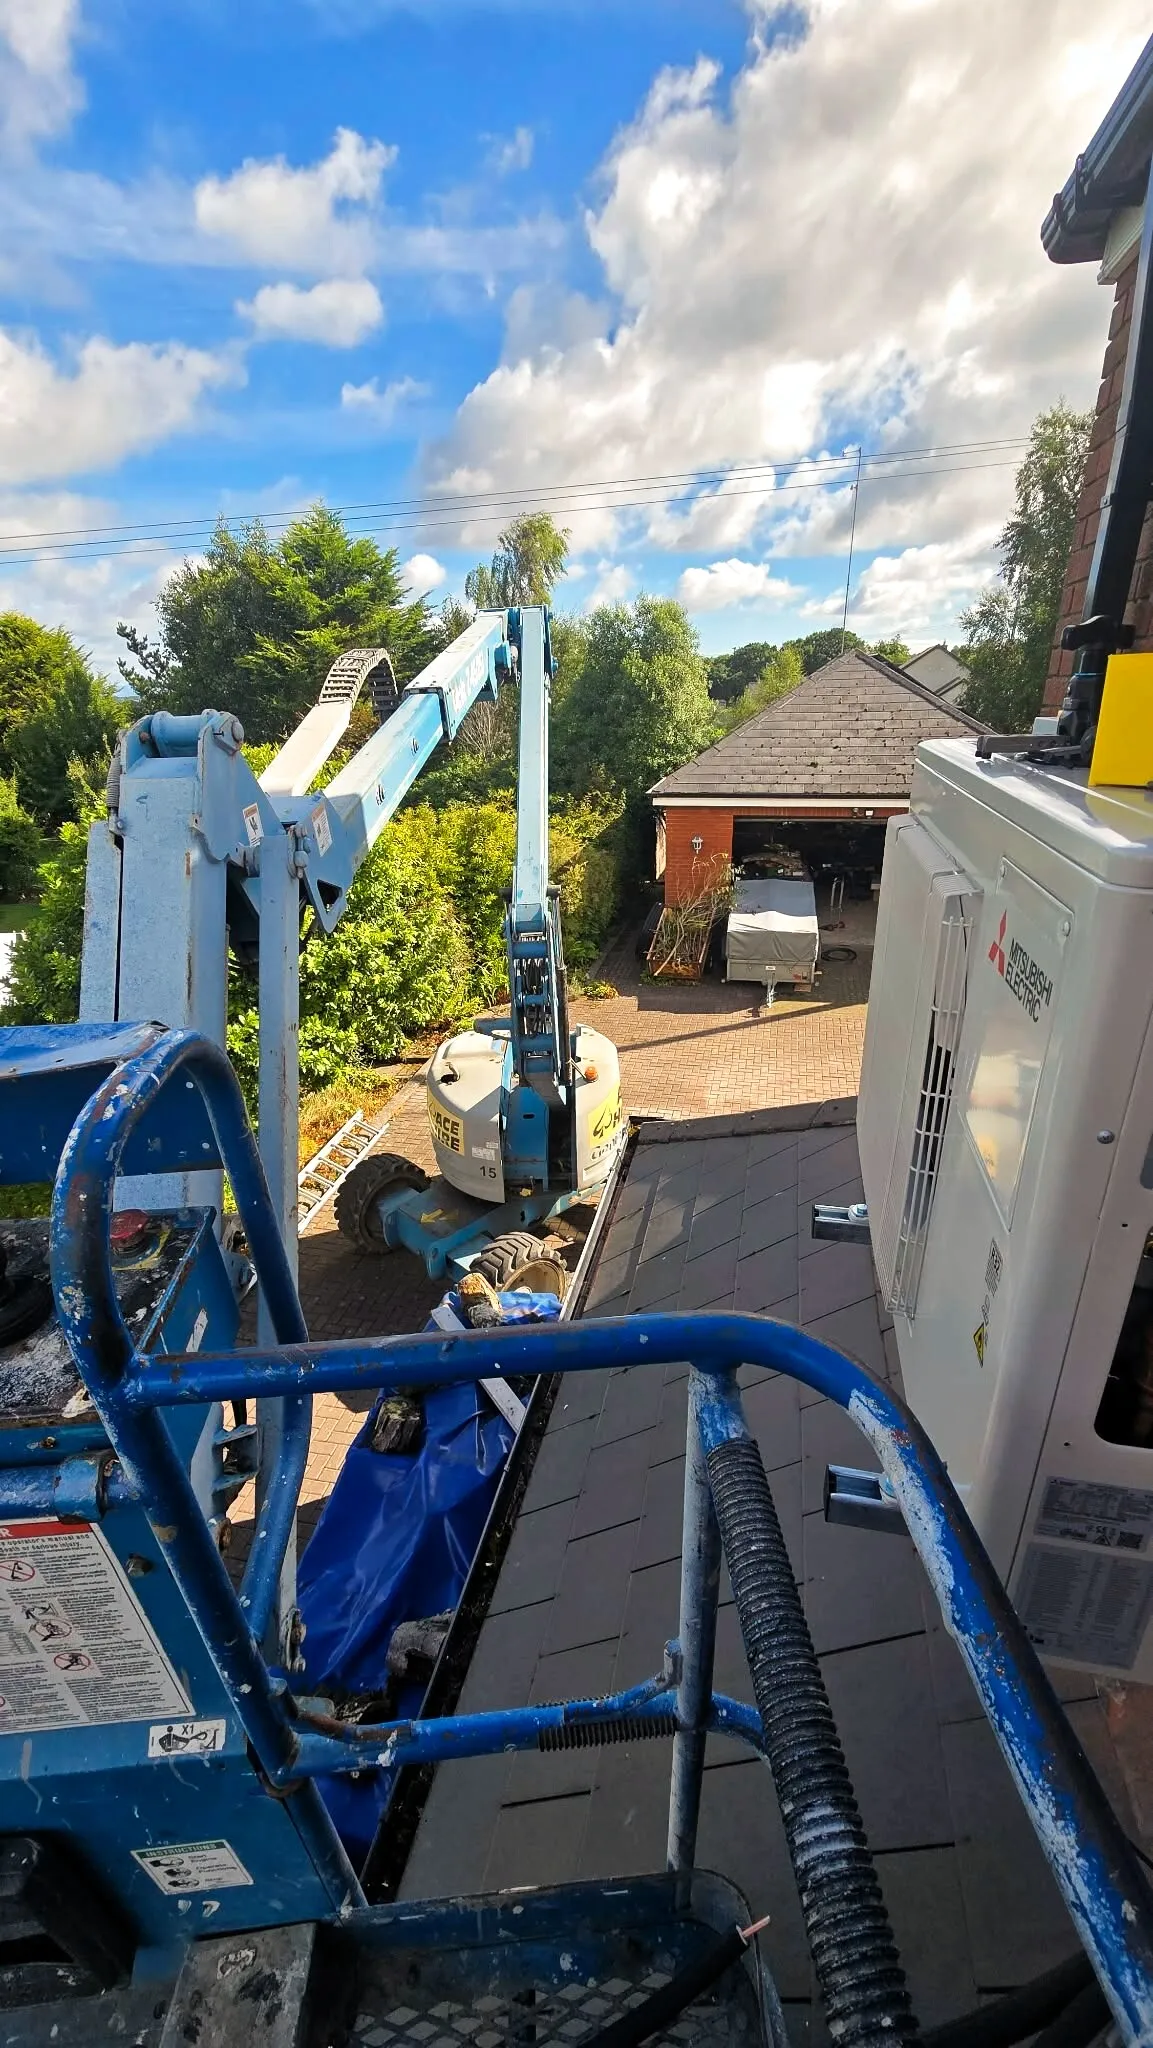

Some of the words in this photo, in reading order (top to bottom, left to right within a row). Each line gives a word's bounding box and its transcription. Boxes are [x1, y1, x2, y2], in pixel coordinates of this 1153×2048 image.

[1009, 938, 1053, 1007] MITSUBISHI
[1005, 961, 1041, 1022] ELECTRIC
[436, 1111, 460, 1136] ACE
[480, 1166, 497, 1178] 15
[181, 1724, 194, 1735] X1
[145, 1843, 217, 1857] INSTRUCTIONS
